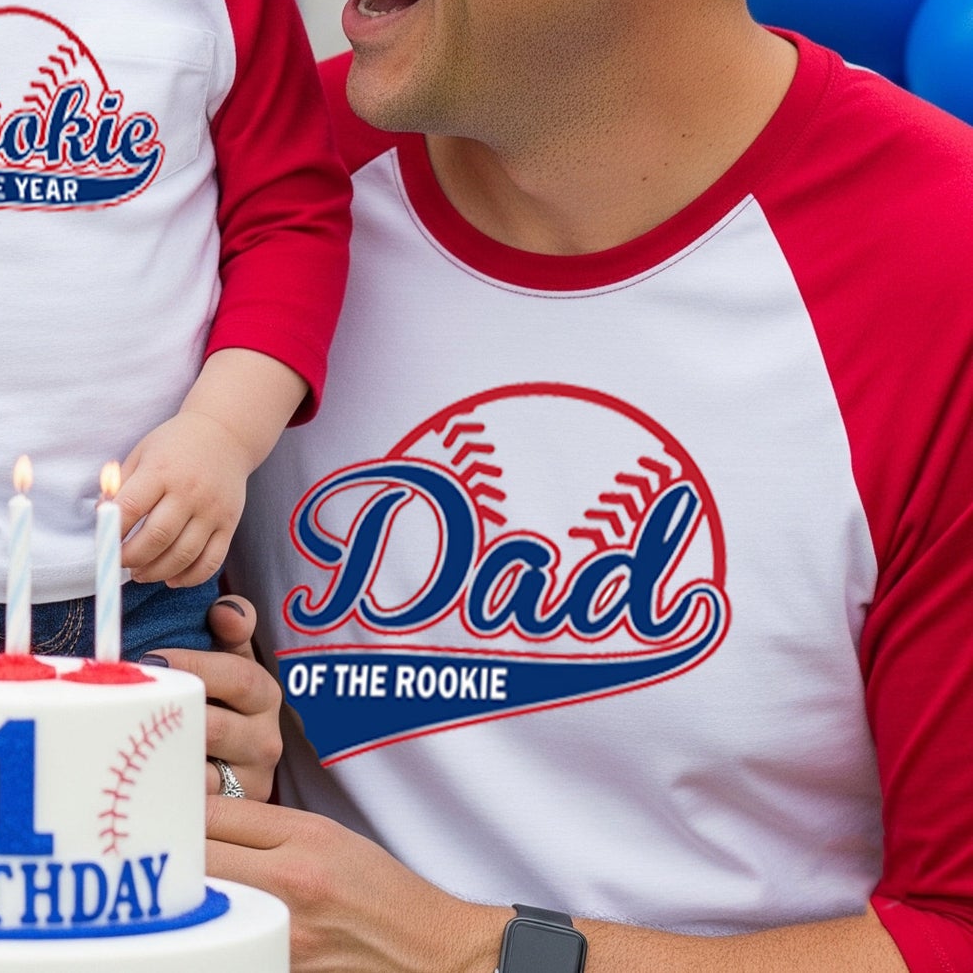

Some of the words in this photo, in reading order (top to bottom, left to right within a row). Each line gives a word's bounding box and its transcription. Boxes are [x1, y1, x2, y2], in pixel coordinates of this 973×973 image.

[15, 177, 78, 202] YEAR
[287, 461, 722, 640] Dad
[287, 663, 326, 697] OF
[334, 664, 388, 698] THE
[394, 666, 508, 700] ROOKIE
